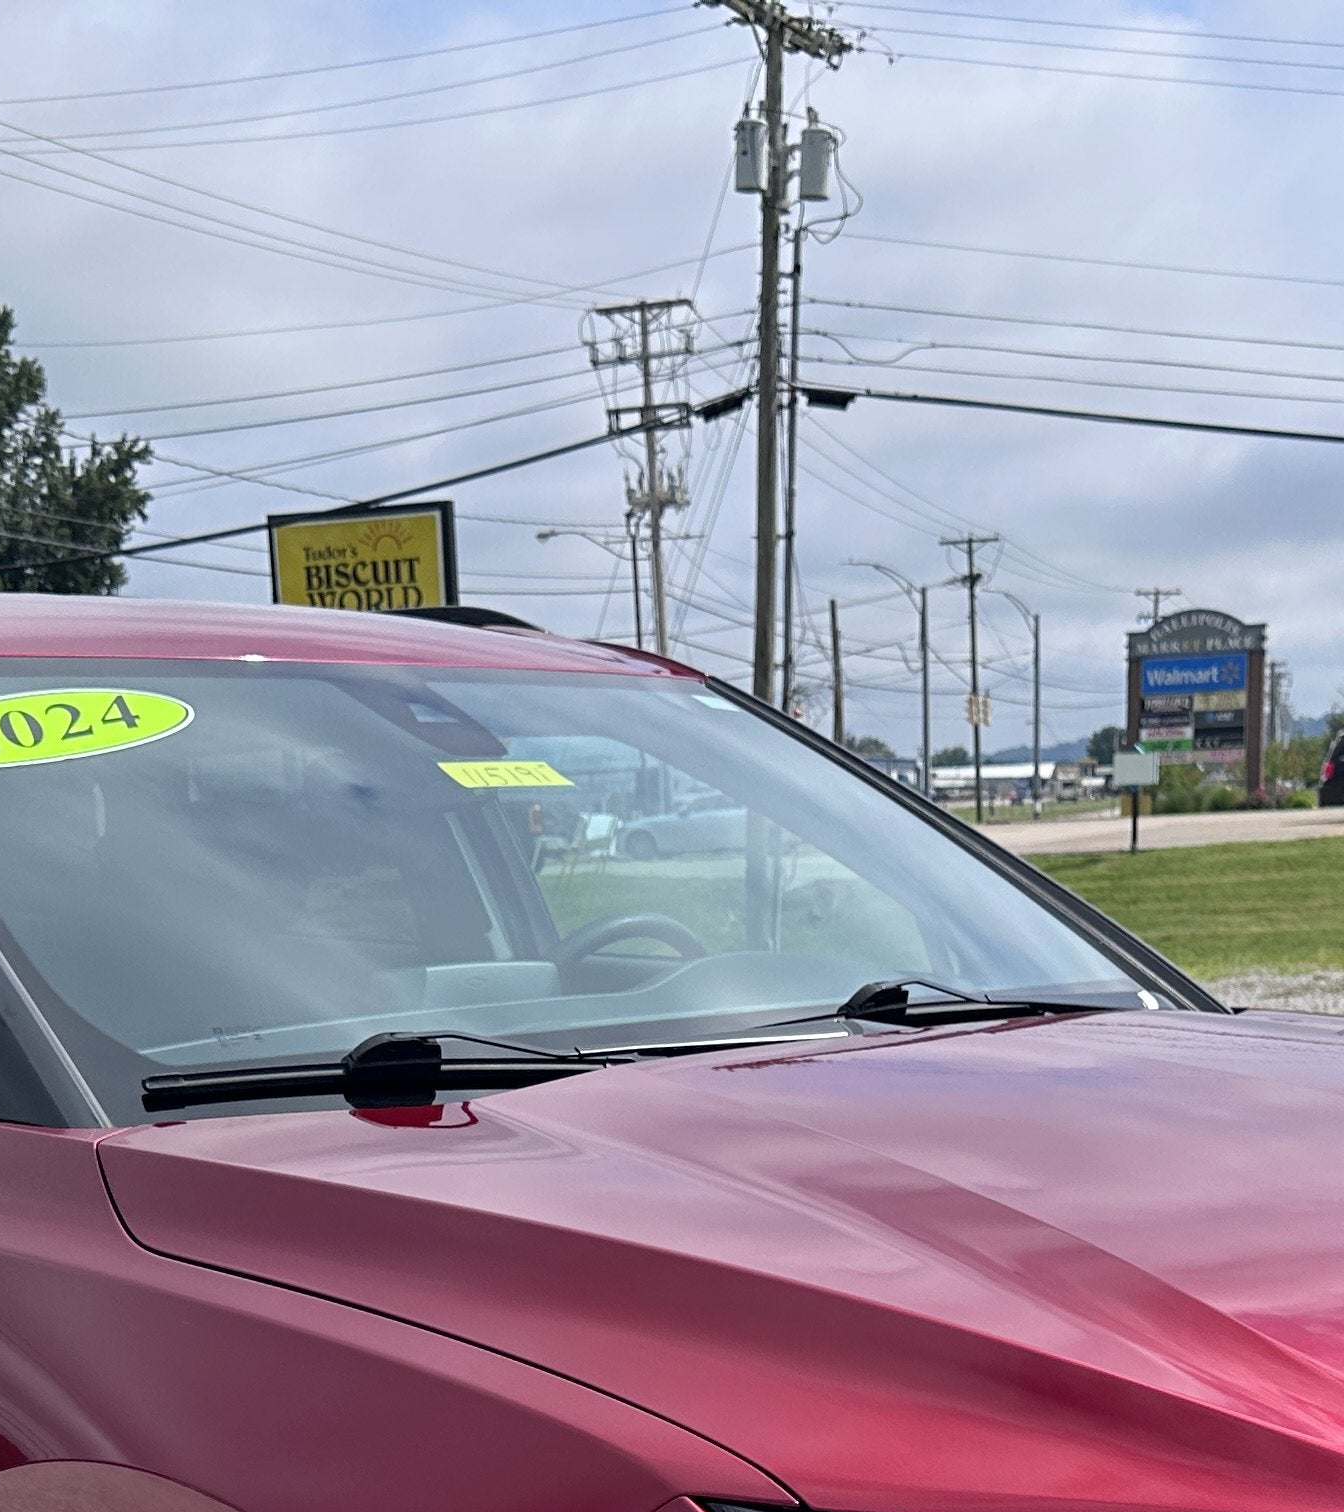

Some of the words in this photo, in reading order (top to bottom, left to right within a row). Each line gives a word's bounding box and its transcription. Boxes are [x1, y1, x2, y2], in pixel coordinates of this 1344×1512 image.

[303, 544, 358, 562] Tudor's
[304, 556, 421, 591] BISCUIT
[307, 586, 423, 612] WORLD
[1146, 666, 1219, 687] Walmart
